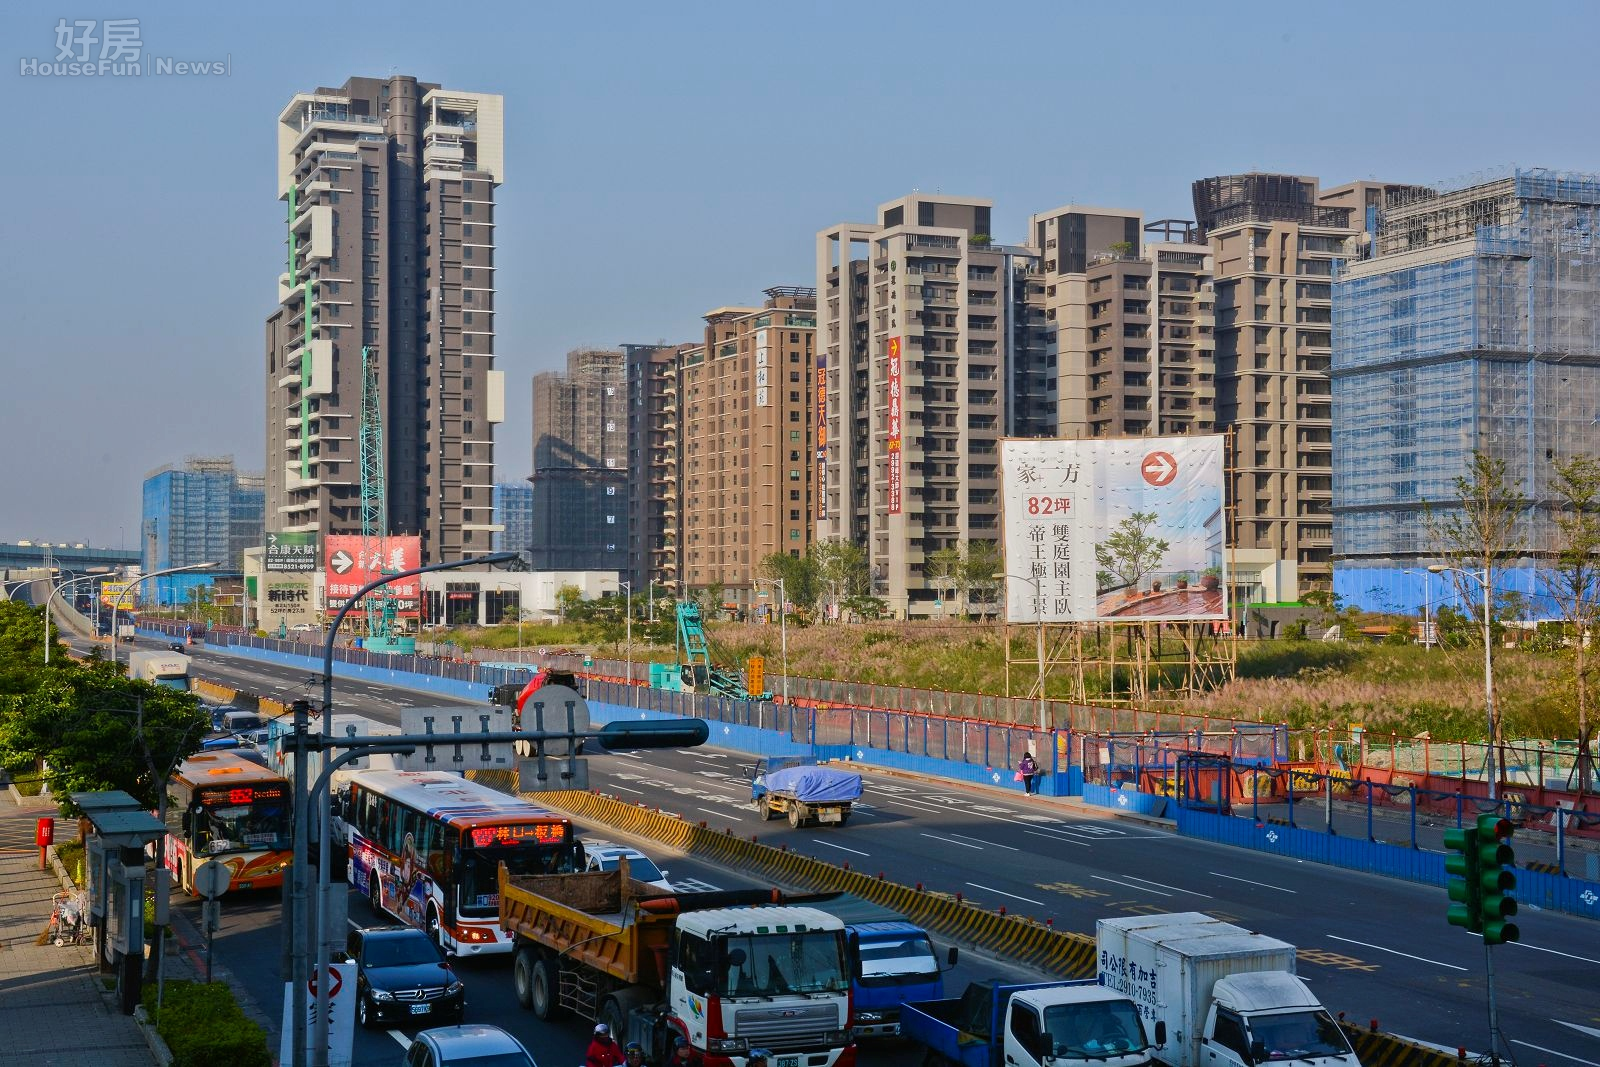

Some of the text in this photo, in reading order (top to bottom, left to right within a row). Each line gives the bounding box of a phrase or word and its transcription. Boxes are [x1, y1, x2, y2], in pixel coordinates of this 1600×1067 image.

[1028, 497, 1070, 515] 82坪
[1053, 524, 1071, 615] 雙庭園主臥
[268, 590, 308, 602] 新時代
[209, 841, 230, 853] 652
